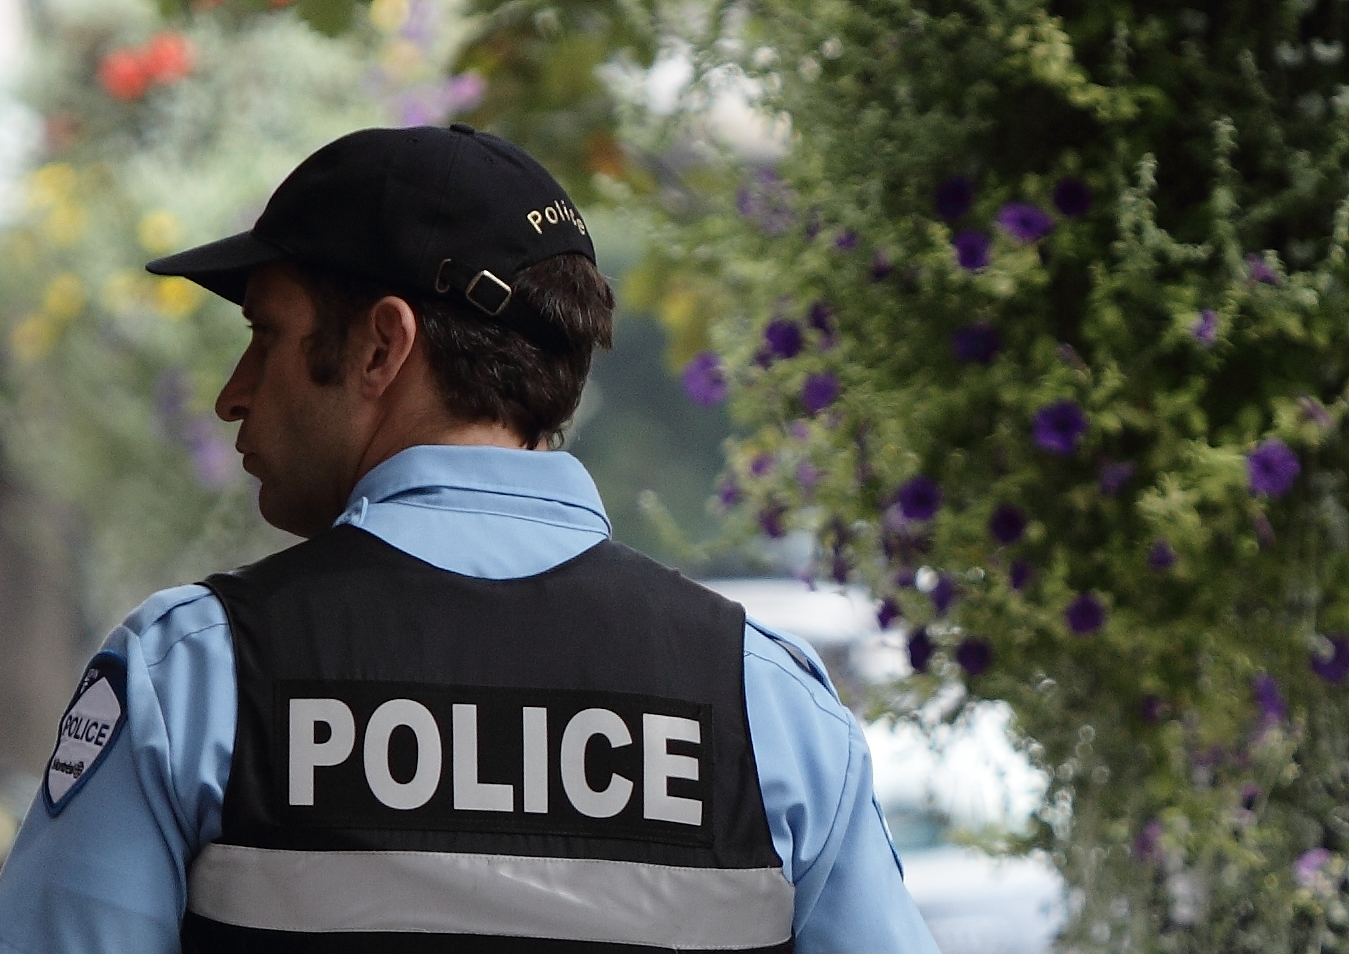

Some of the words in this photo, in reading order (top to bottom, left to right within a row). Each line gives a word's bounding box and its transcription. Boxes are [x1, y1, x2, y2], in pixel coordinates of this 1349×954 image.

[527, 199, 586, 235] Police
[62, 714, 110, 746] POLICE
[289, 698, 703, 826] POLICE
